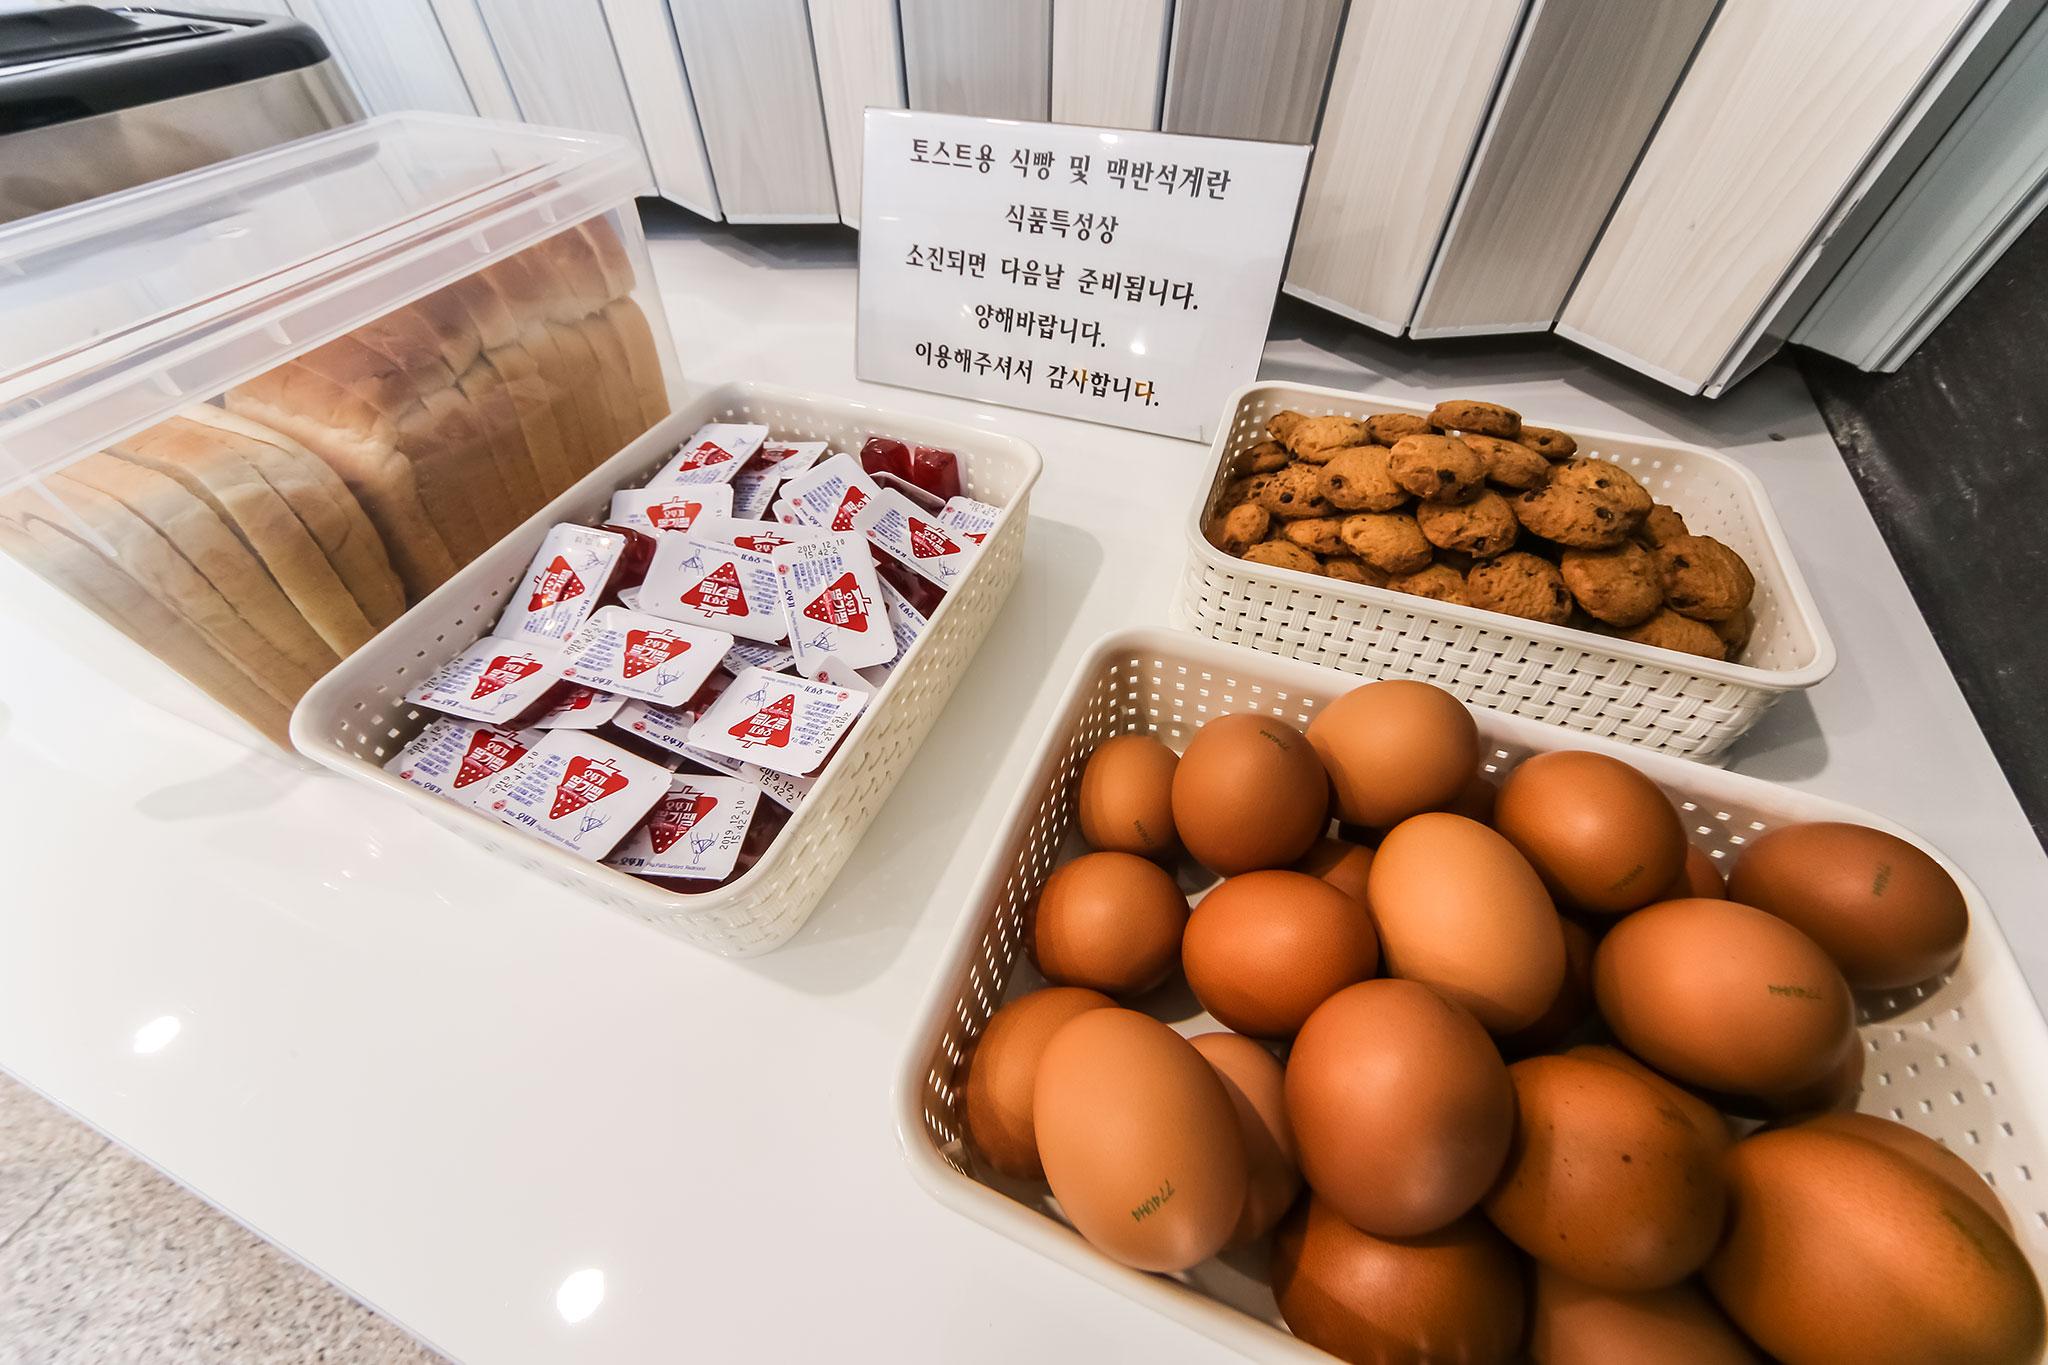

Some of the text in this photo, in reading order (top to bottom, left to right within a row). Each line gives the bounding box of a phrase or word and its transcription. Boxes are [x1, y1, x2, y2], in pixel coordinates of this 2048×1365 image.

[910, 138, 1232, 200] 토스트용 식빵 및 맥반석계란
[1005, 204, 1119, 244] 식품특성상
[905, 244, 1199, 310] 소진되면 다음날 준비됩니다.
[974, 304, 1106, 348] 양해바랍니다.
[915, 342, 1159, 407] 이용해주셔서 감사합니다.
